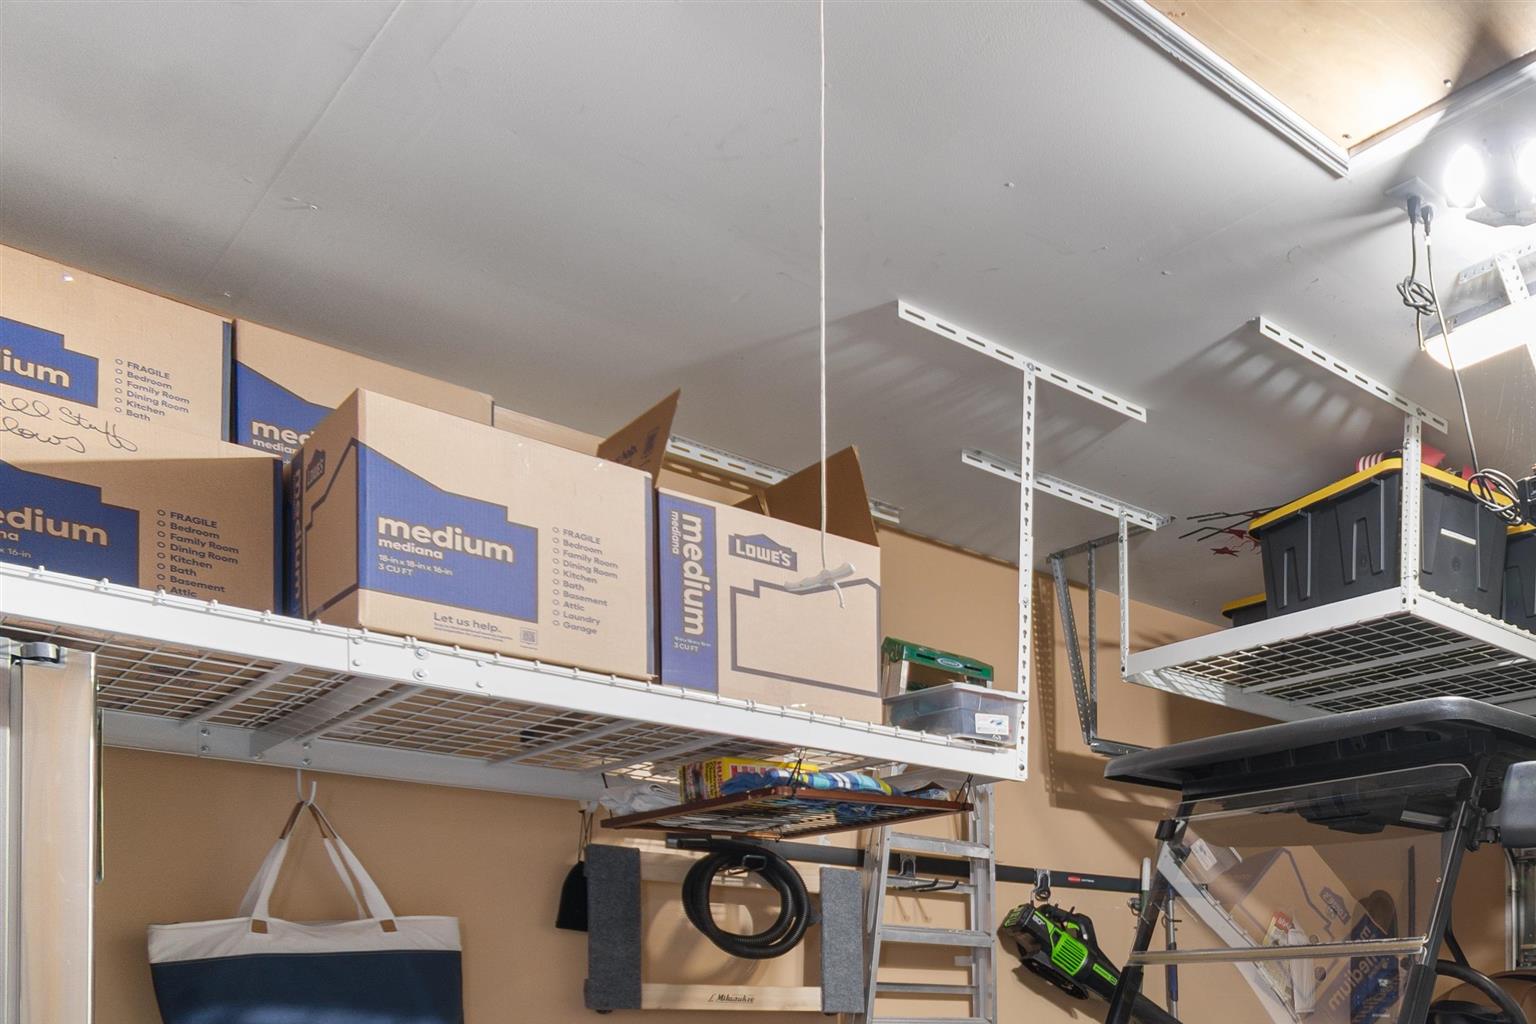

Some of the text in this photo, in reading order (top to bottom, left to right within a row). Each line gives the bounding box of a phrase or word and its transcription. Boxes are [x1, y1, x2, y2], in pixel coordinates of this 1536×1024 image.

[0, 349, 70, 388] ium
[127, 361, 170, 379] FRAGILE
[127, 371, 172, 390] Bedroom
[127, 381, 190, 404] Family Room
[127, 390, 189, 413] Dining Room
[127, 400, 165, 416] Kitchen
[126, 409, 151, 421] Bath
[0, 507, 108, 546] dium
[170, 511, 218, 528] FRAGILE
[170, 522, 220, 539] Bedroom
[563, 528, 600, 544] FRAGILE
[671, 510, 680, 555] mediana
[170, 533, 239, 554] Family Room
[378, 516, 514, 563] medium
[563, 539, 603, 555] Bedroom
[170, 543, 238, 564] Dining Room
[378, 538, 444, 560] mediana
[736, 538, 791, 567] LOWE'S
[170, 554, 213, 569] Kitchen
[563, 549, 618, 569] Family Room
[170, 564, 197, 577] Bath
[386, 564, 400, 574] CU
[401, 567, 414, 577] FT
[563, 560, 618, 579] Dining Room
[563, 569, 598, 584] Kitchen
[682, 513, 711, 635] medium
[170, 575, 225, 593] Basement
[170, 586, 198, 598] Attic
[563, 580, 585, 591] Bath
[563, 590, 608, 607] Basement
[563, 600, 585, 611] Attic
[434, 612, 454, 623] Let
[456, 617, 470, 627] us
[563, 610, 600, 625] Laundry
[563, 621, 598, 635] Garage
